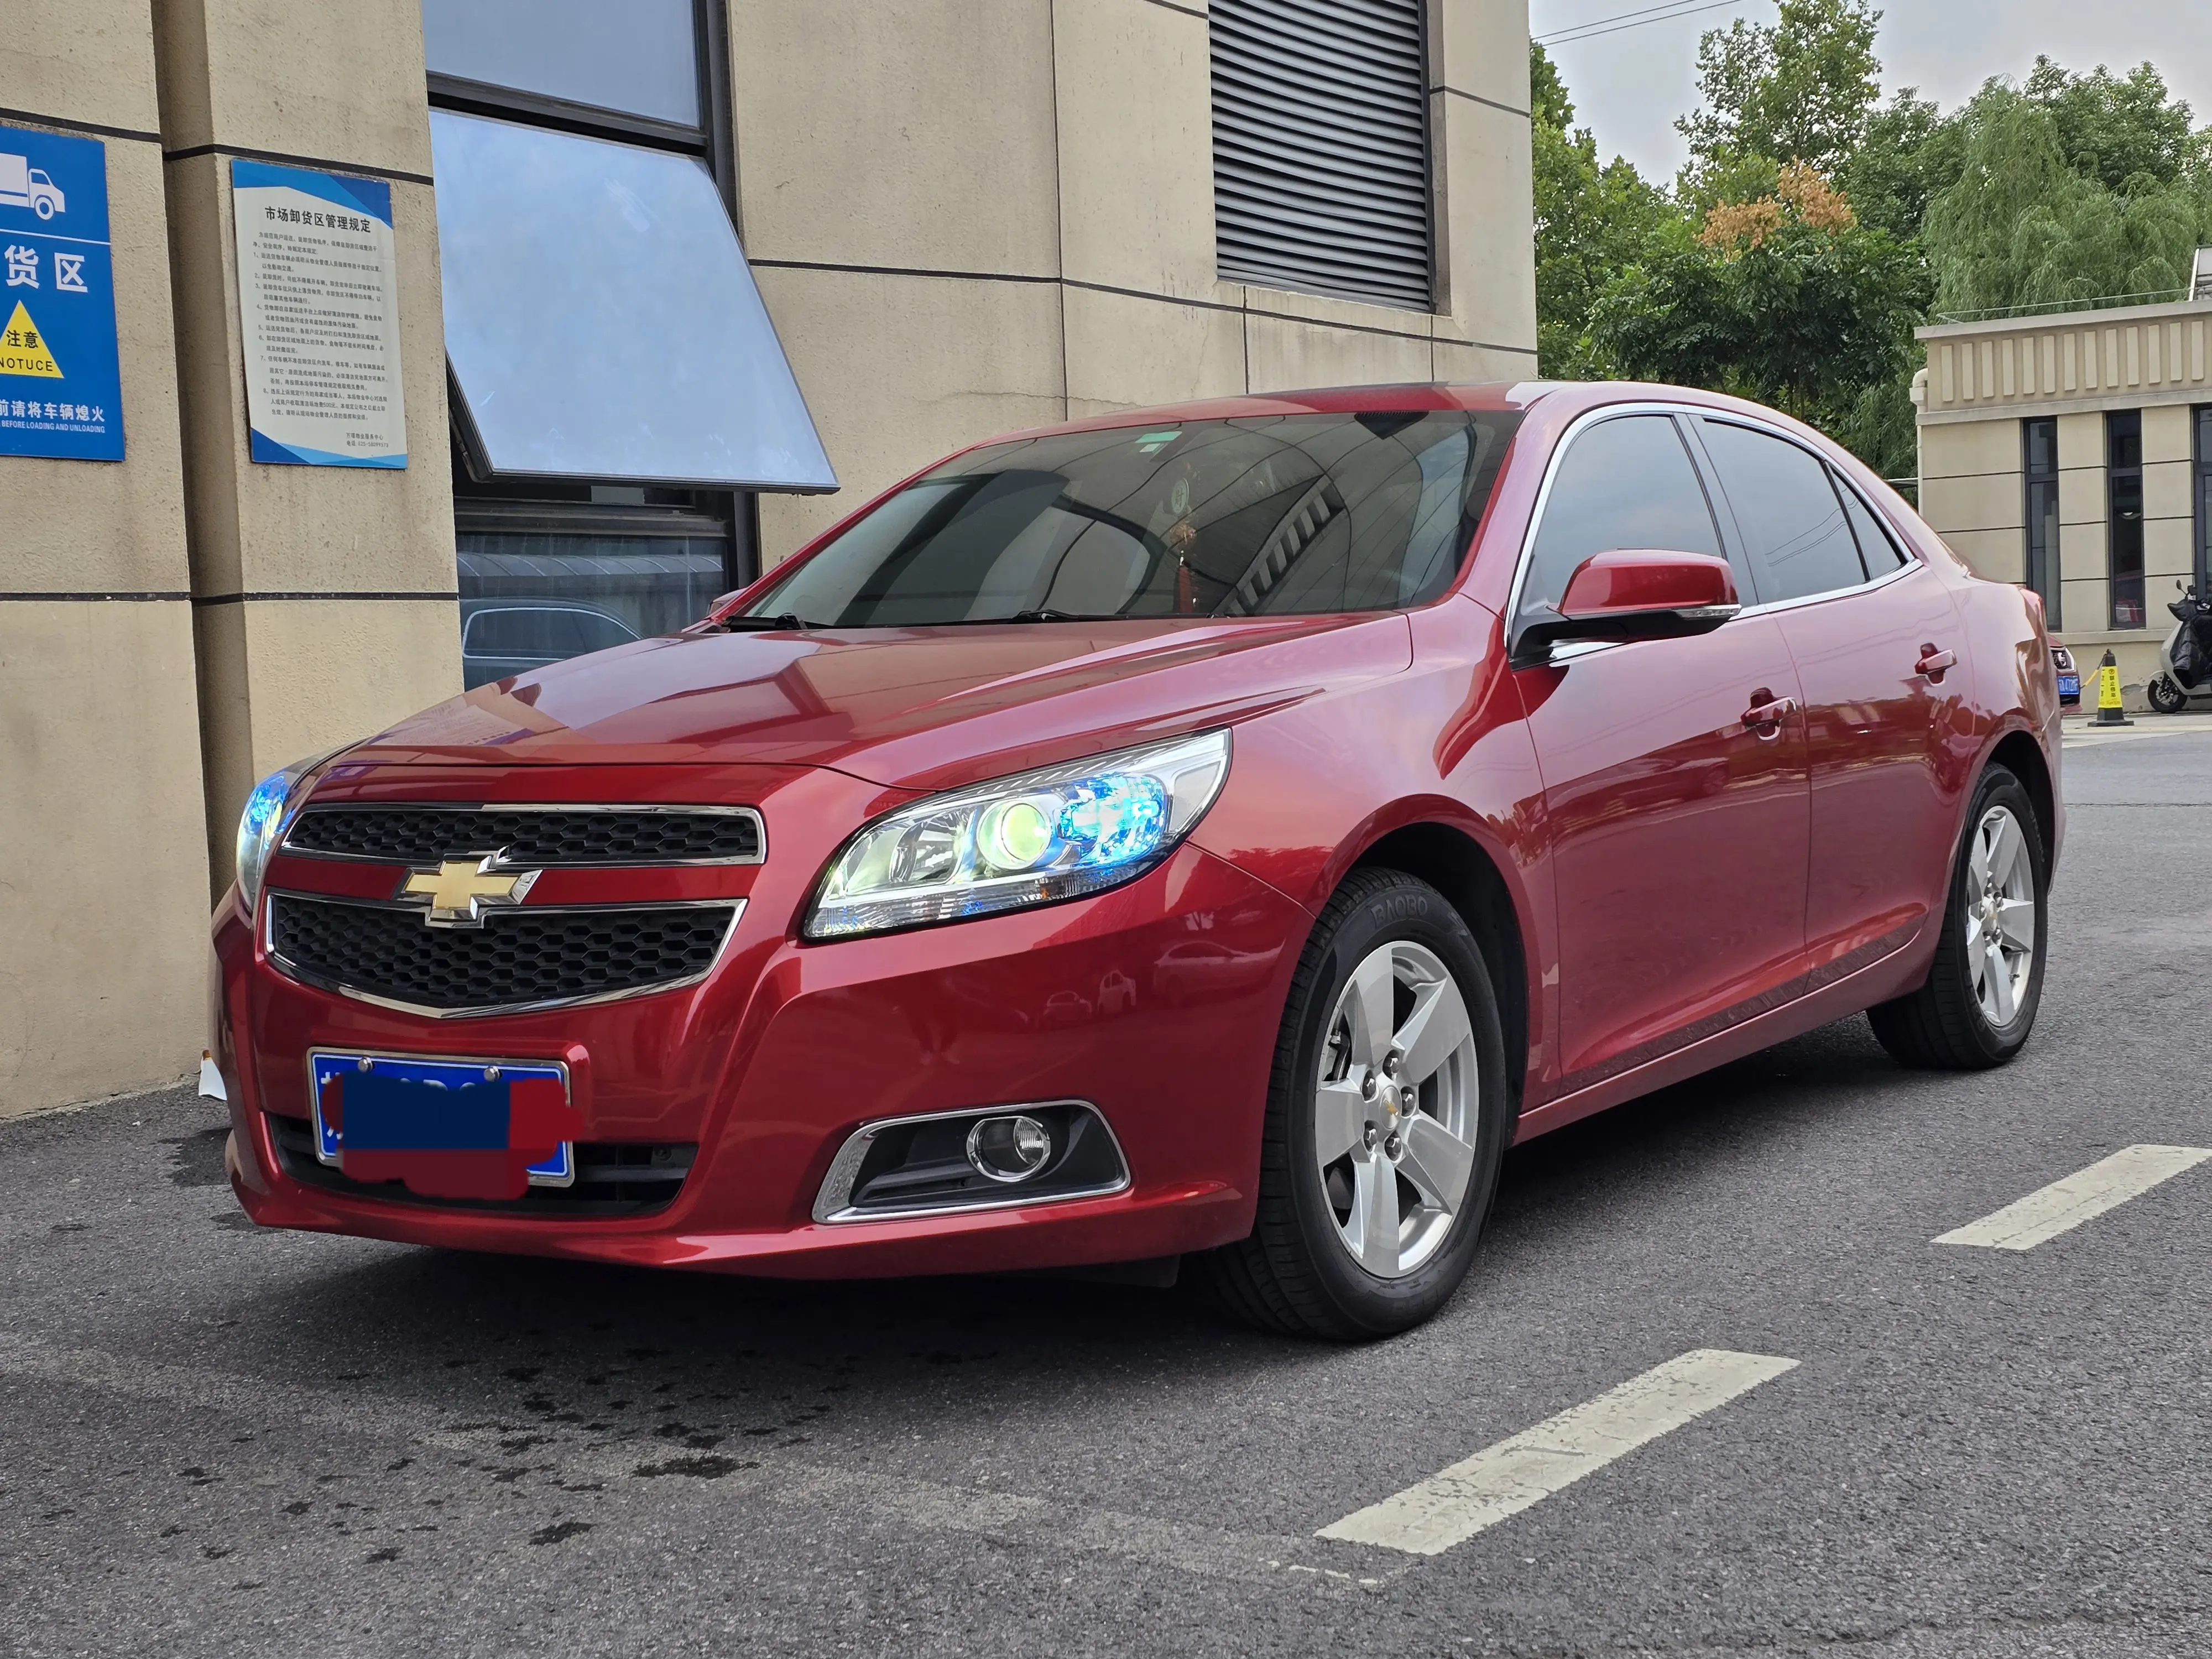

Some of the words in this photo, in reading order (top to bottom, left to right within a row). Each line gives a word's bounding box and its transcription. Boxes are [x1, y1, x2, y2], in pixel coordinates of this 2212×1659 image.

[264, 206, 371, 233] 市场卸货区管理规定
[7, 330, 38, 349] 注意
[2, 420, 25, 429] BEFORE
[27, 421, 55, 430] LOADING
[70, 424, 105, 433] UNLOADING
